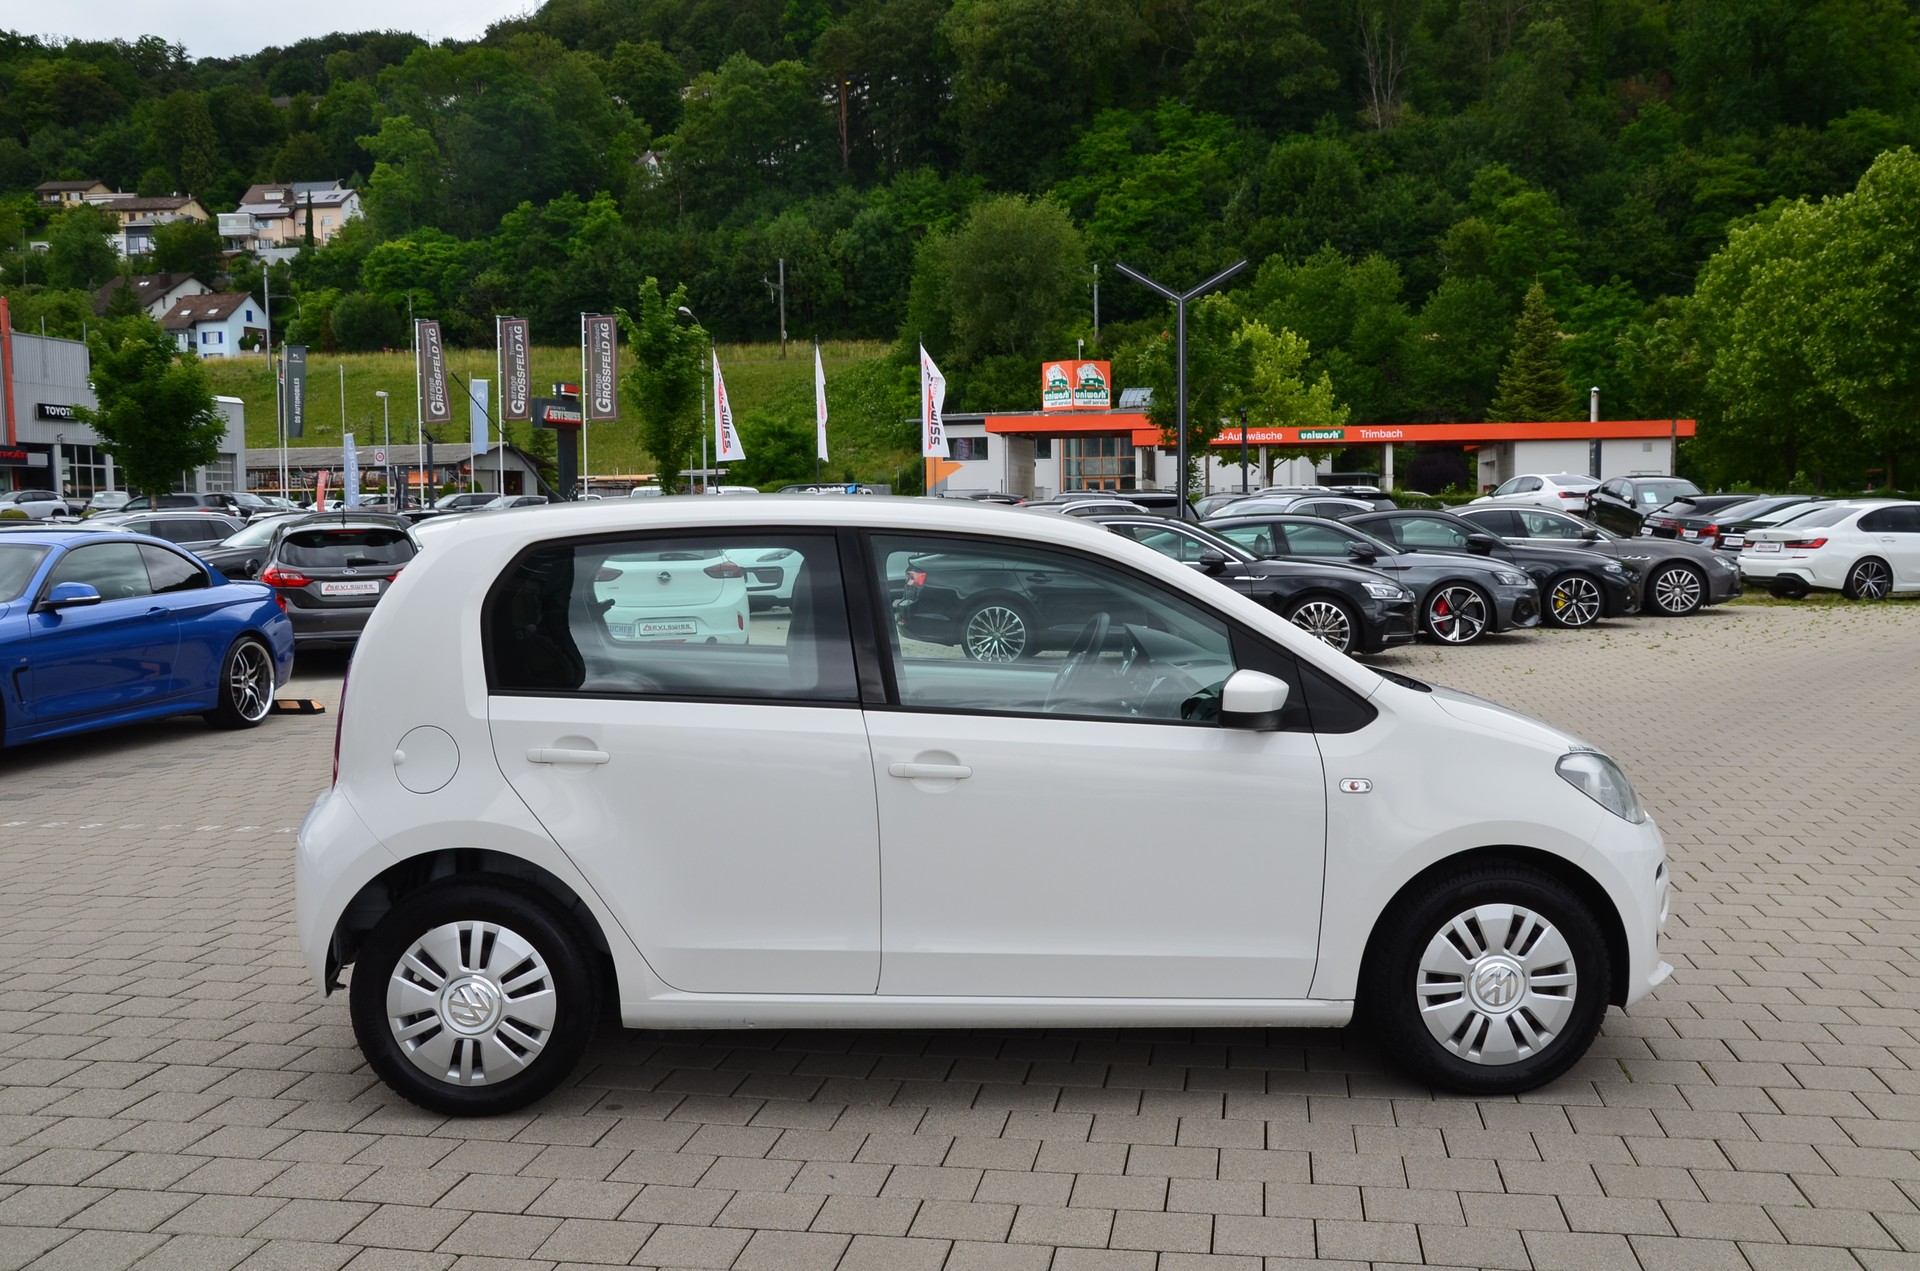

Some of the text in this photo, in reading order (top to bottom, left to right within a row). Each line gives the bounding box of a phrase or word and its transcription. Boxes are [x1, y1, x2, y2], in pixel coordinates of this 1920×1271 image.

[429, 327, 438, 344] AG
[511, 325, 526, 414] GROSSFELD AG
[595, 322, 612, 413] GROSSFELD AG
[1044, 390, 1070, 401] uniwash
[1075, 389, 1106, 399] uniwash
[45, 405, 72, 417] TOYOT
[1213, 431, 1283, 441] B-Autwäsche
[1300, 430, 1339, 440] uniwash
[1360, 429, 1403, 439] Trimbach
